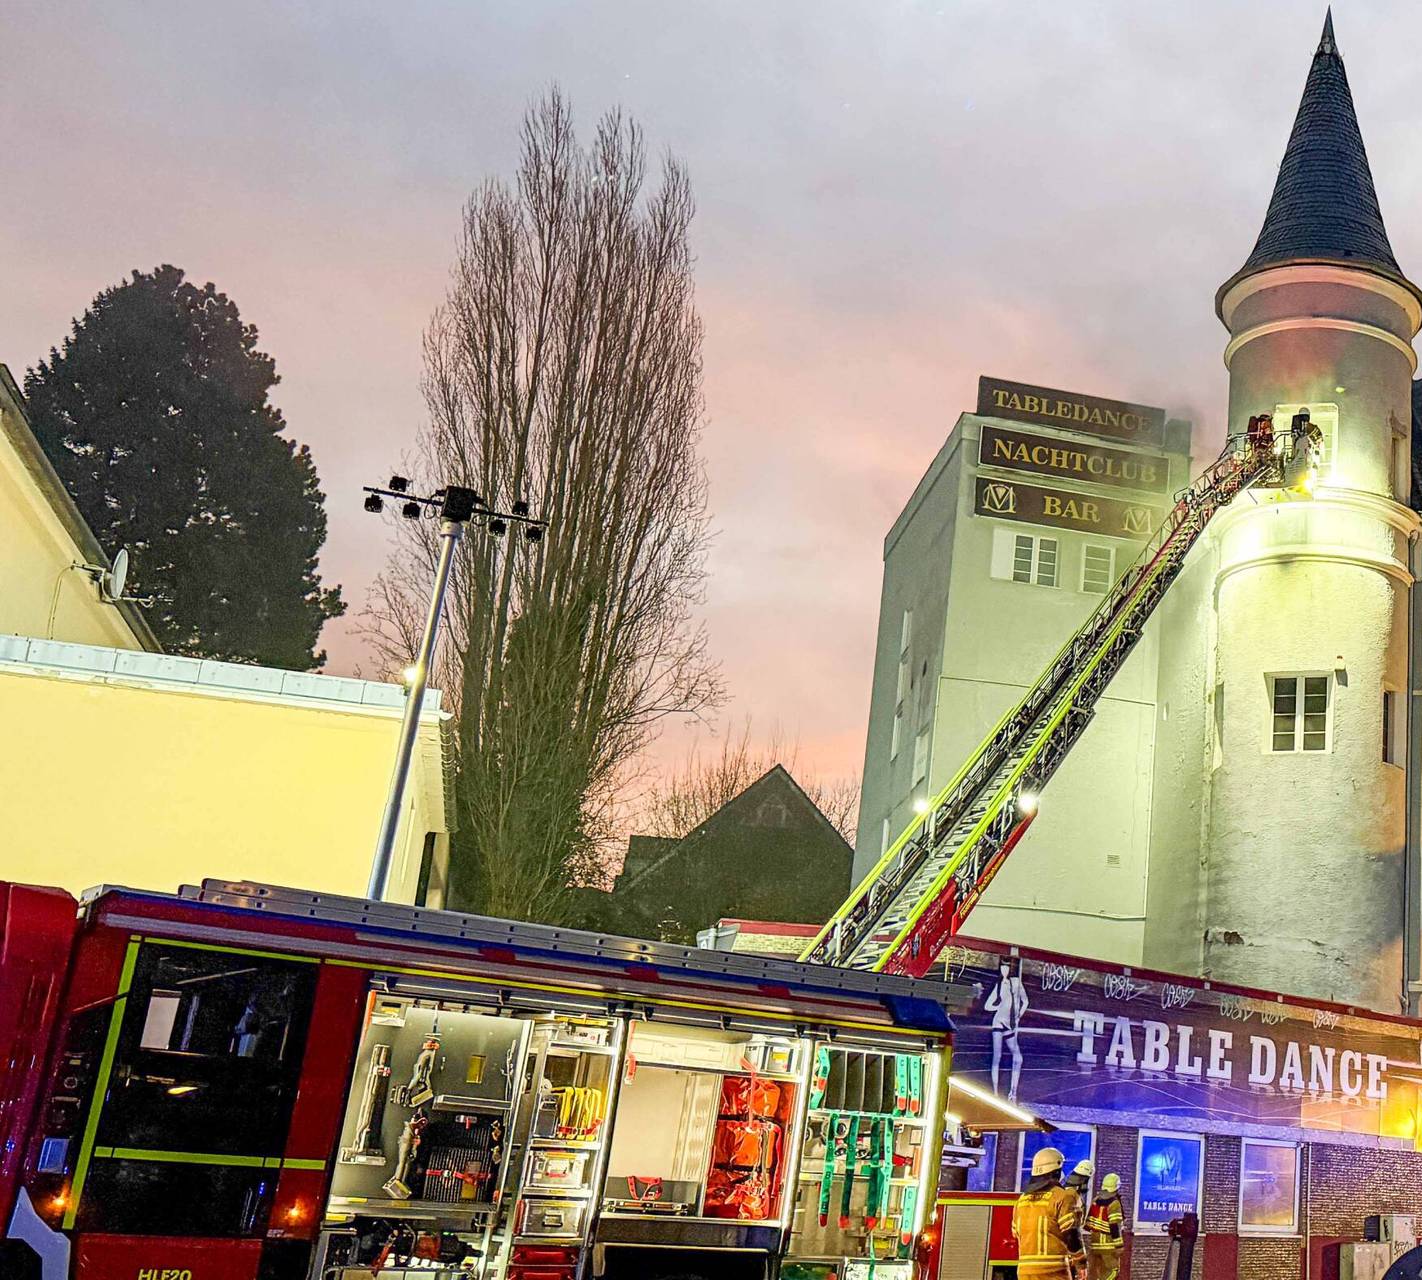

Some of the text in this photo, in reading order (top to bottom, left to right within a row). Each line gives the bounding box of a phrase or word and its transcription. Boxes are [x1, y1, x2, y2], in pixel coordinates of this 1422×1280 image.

[993, 389, 1152, 433] TABLEDANCE
[993, 438, 1157, 483] NACHTCLUB
[1043, 495, 1100, 523] BAR
[1073, 1009, 1388, 1099] TABLE DANCE
[1143, 1201, 1193, 1213] TABLE DANCE
[138, 1268, 192, 1280] HLF20
